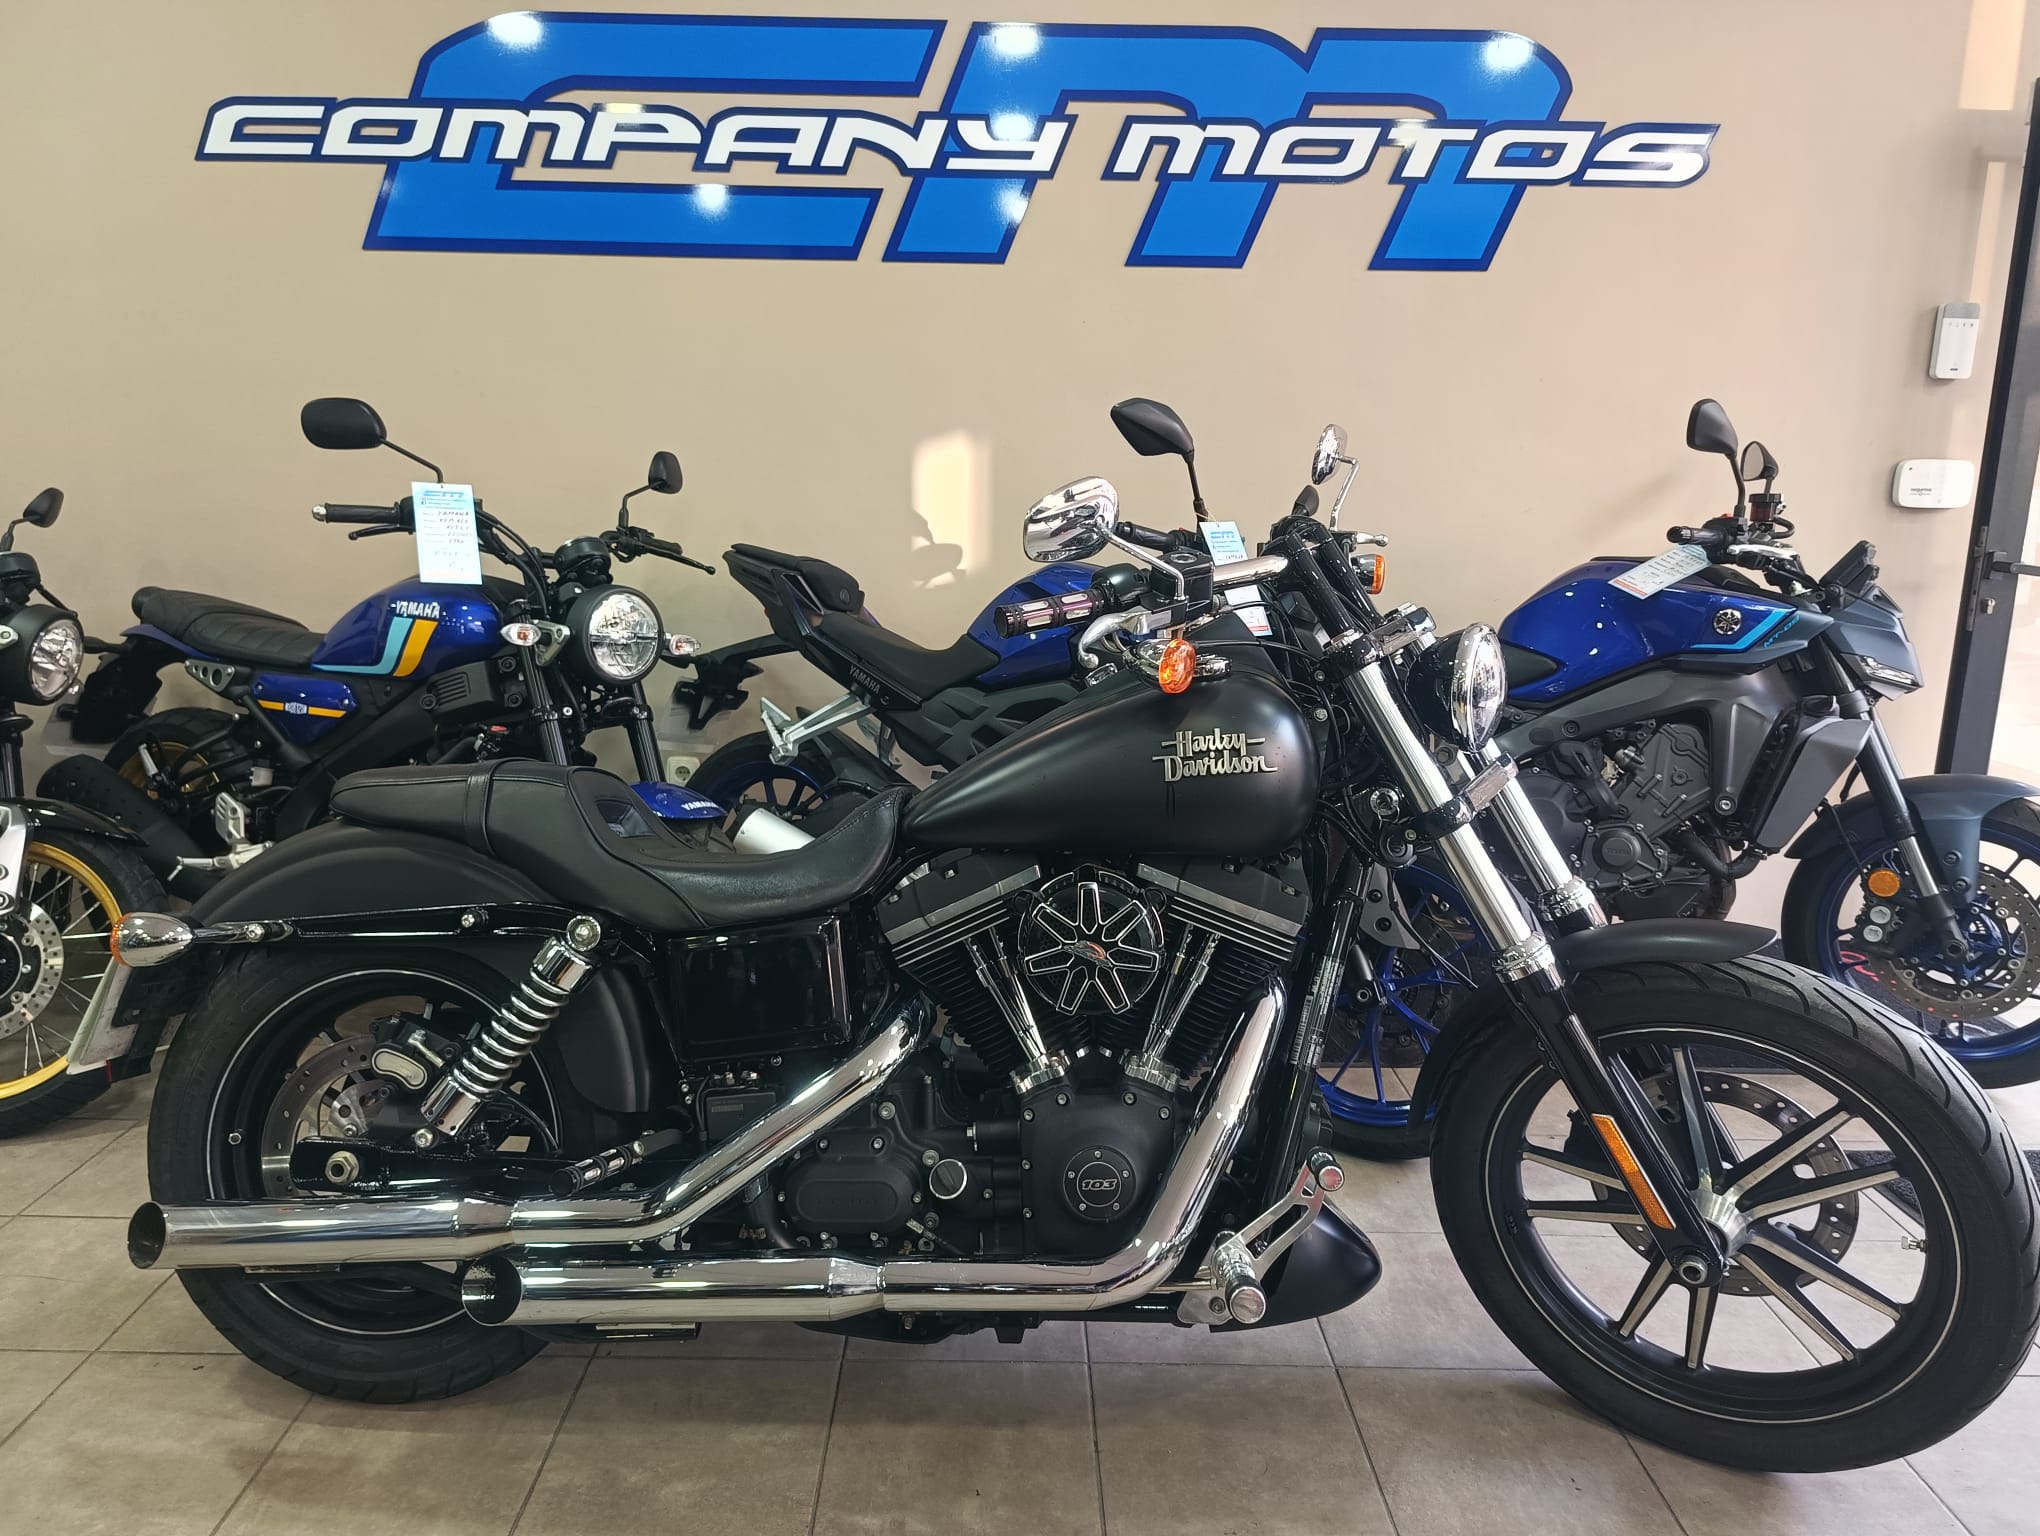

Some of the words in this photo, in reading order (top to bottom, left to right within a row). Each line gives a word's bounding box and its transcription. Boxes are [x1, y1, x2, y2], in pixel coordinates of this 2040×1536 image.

[197, 98, 1075, 178] COMPANY
[1104, 118, 1719, 187] MOTOS
[396, 600, 440, 619] YAMAHA
[850, 664, 881, 695] YAMAHA
[1152, 750, 1278, 782] Davidson
[1082, 1179, 1118, 1191] 103
